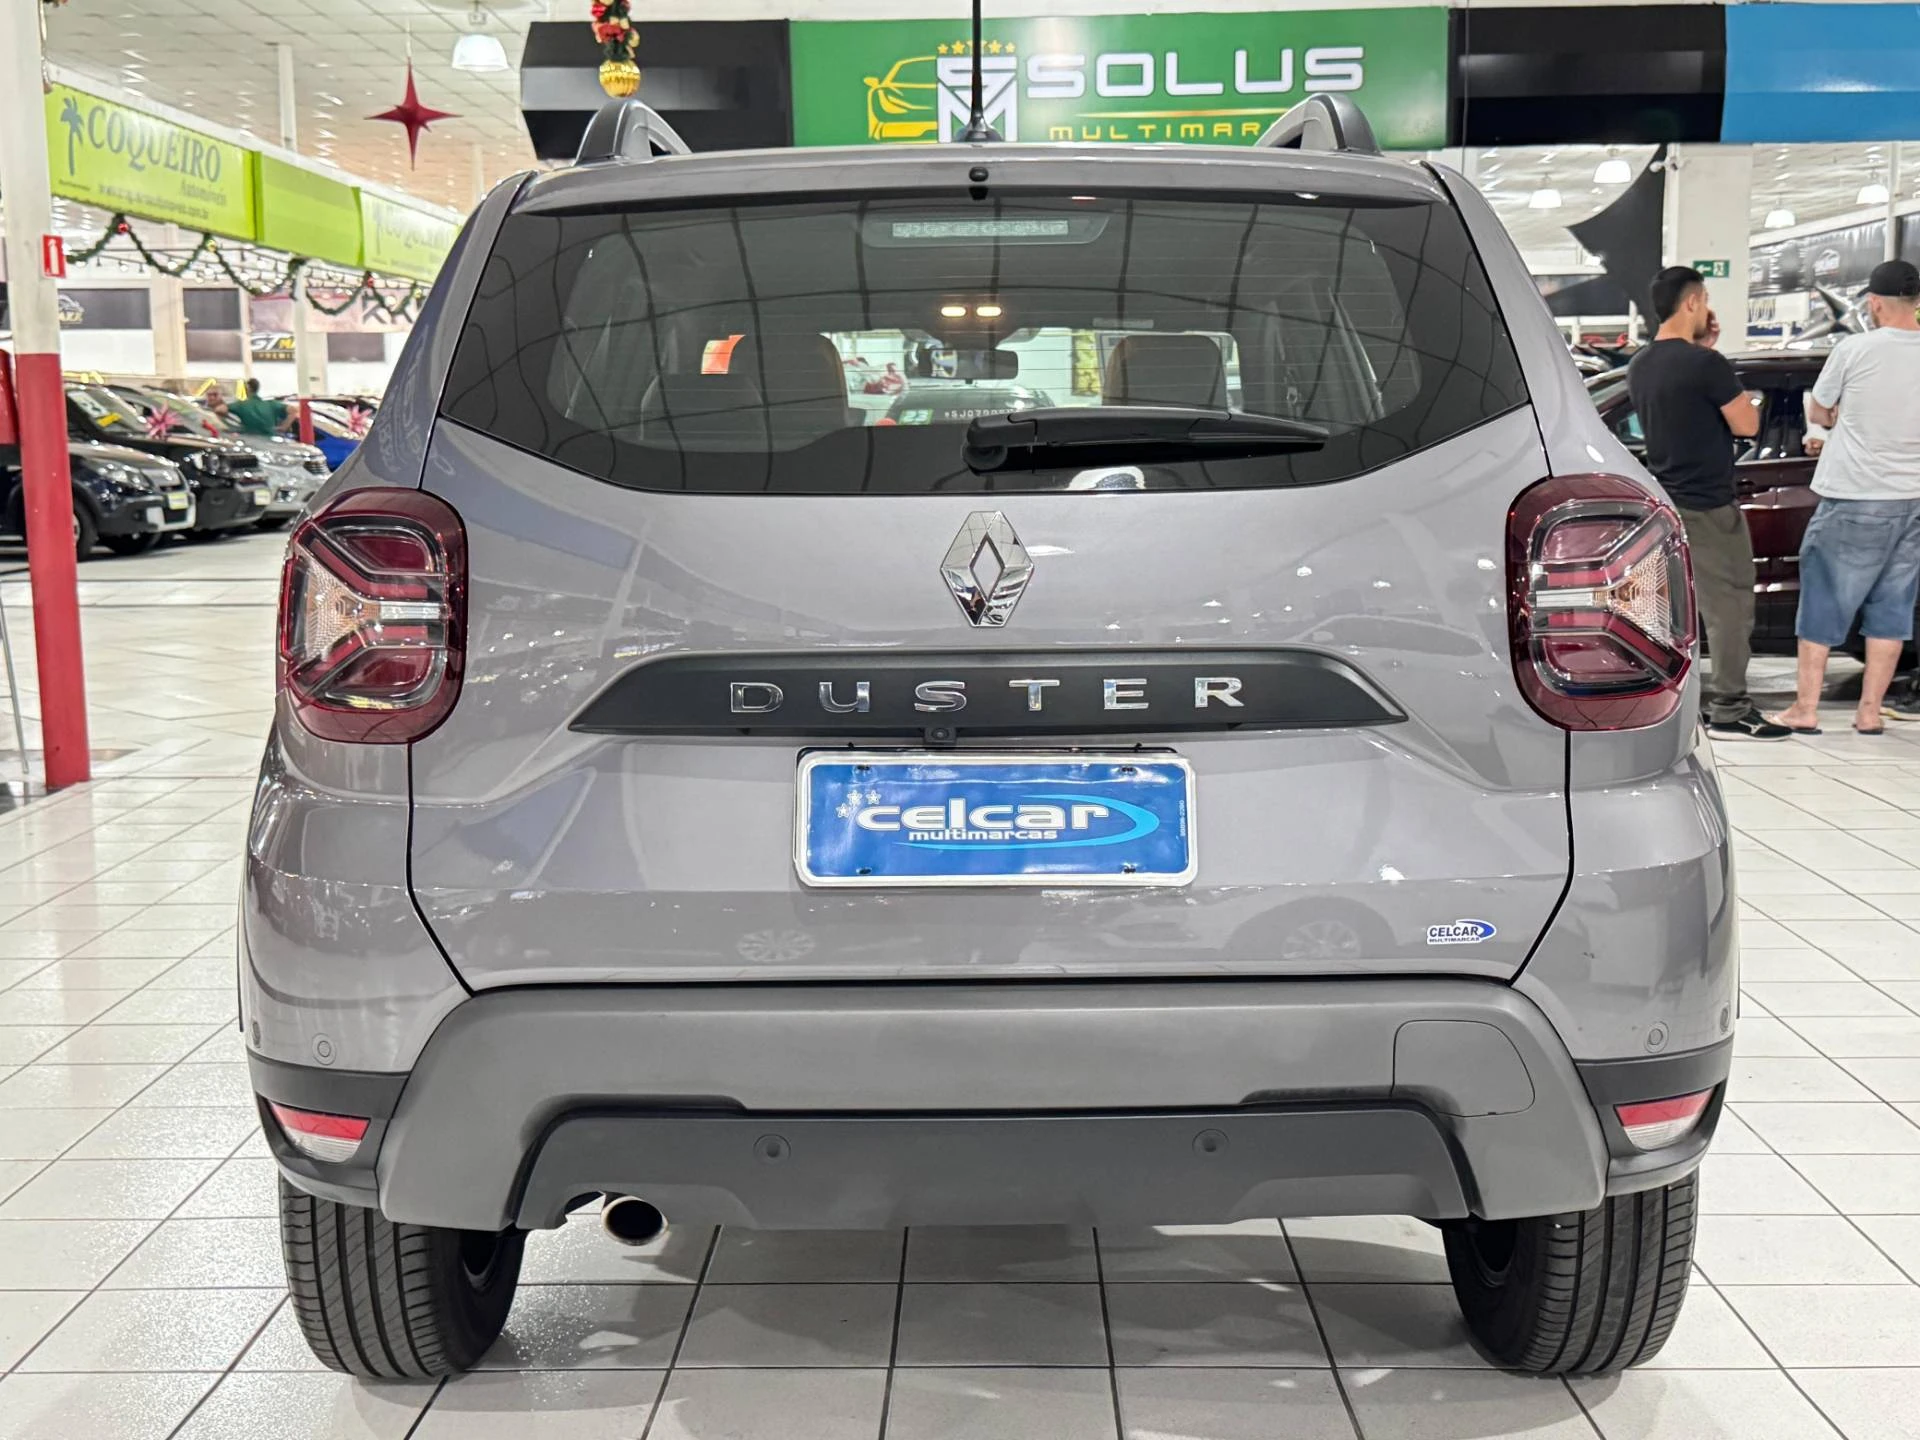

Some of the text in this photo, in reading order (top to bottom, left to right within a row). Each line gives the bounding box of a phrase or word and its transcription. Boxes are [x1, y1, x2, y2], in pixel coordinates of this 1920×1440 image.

[1026, 46, 1365, 99] SOLUS
[87, 105, 221, 182] COQUEIRO
[1050, 122, 1261, 141] MULTIMAR
[730, 676, 1245, 713] DUSTER
[855, 798, 1109, 831] celcar
[908, 828, 1058, 841] multimarcas
[1429, 926, 1479, 937] CELCAR
